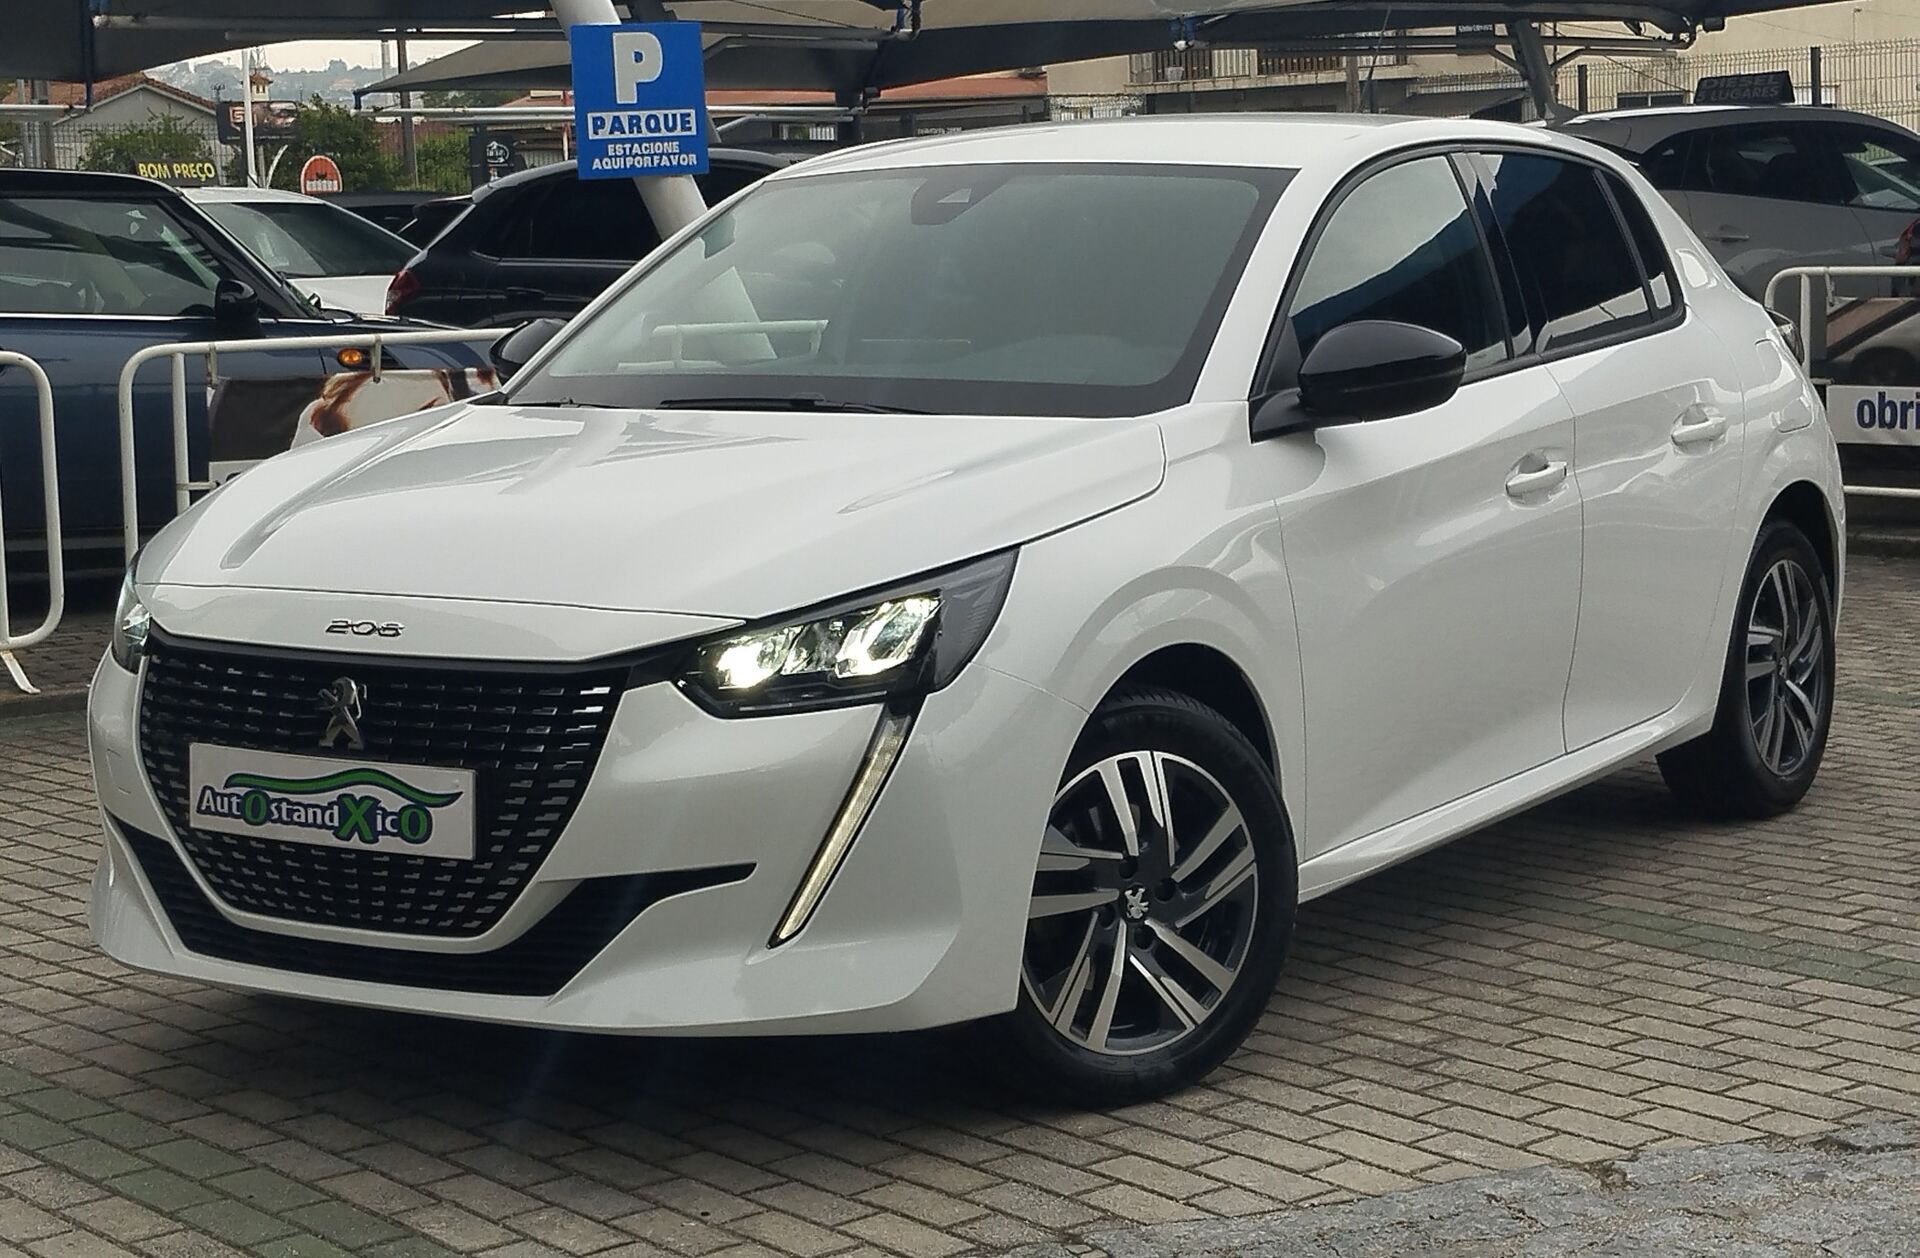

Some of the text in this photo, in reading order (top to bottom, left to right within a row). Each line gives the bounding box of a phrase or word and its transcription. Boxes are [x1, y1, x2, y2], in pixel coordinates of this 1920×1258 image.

[613, 31, 663, 104] P
[1702, 75, 1779, 90] DIESEL
[1711, 87, 1779, 101] LUGARES
[591, 112, 693, 136] PARQUE
[607, 141, 680, 156] ESTACIONE
[138, 162, 216, 182] BOM PREÇO
